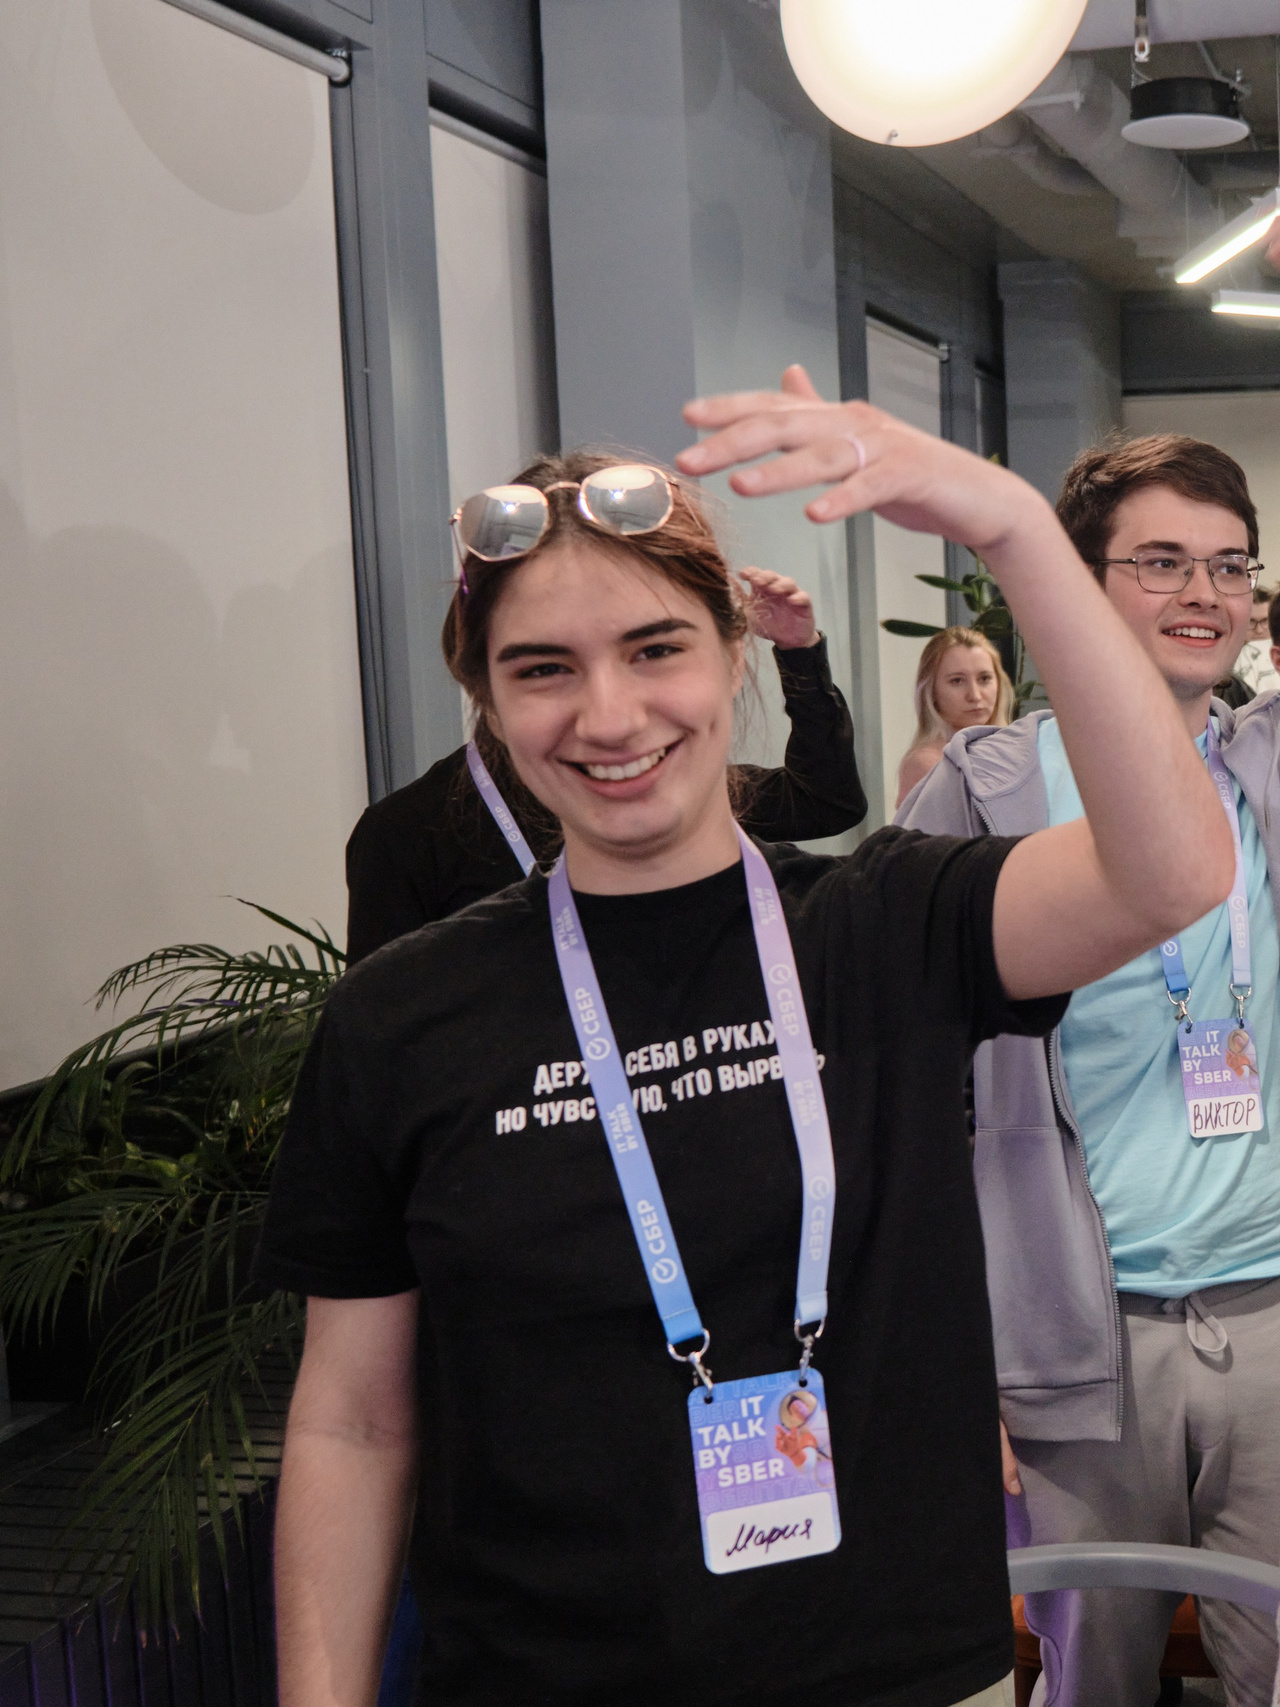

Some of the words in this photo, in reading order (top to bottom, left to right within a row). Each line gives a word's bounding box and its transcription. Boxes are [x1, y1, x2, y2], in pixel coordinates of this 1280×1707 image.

[1218, 783, 1232, 809] СБЕР
[494, 806, 513, 830] СБЕР
[1235, 913, 1246, 949] СБЕР
[575, 987, 600, 1035] СБЕР
[776, 988, 800, 1036] СБЕР
[1205, 1030, 1220, 1043] IT
[533, 1060, 590, 1096] ДЕР
[625, 1041, 680, 1077] СЕБЯ
[682, 1035, 699, 1062] В
[1182, 1045, 1221, 1059] TALK
[1183, 1059, 1202, 1073] BY
[1194, 1069, 1233, 1085] SBER
[495, 1107, 527, 1135] НО
[671, 1069, 713, 1101] ЧТО
[1193, 1097, 1256, 1134] ВИКТОР
[606, 1109, 624, 1141] TALK
[616, 1141, 628, 1153] IT
[636, 1199, 666, 1255] СБЕР
[808, 1206, 826, 1261] СБЕР
[740, 1395, 764, 1418] IT
[697, 1417, 767, 1447] TALK
[698, 1445, 732, 1470] BY
[718, 1458, 785, 1488] SBER
[726, 1518, 812, 1556] Мария
